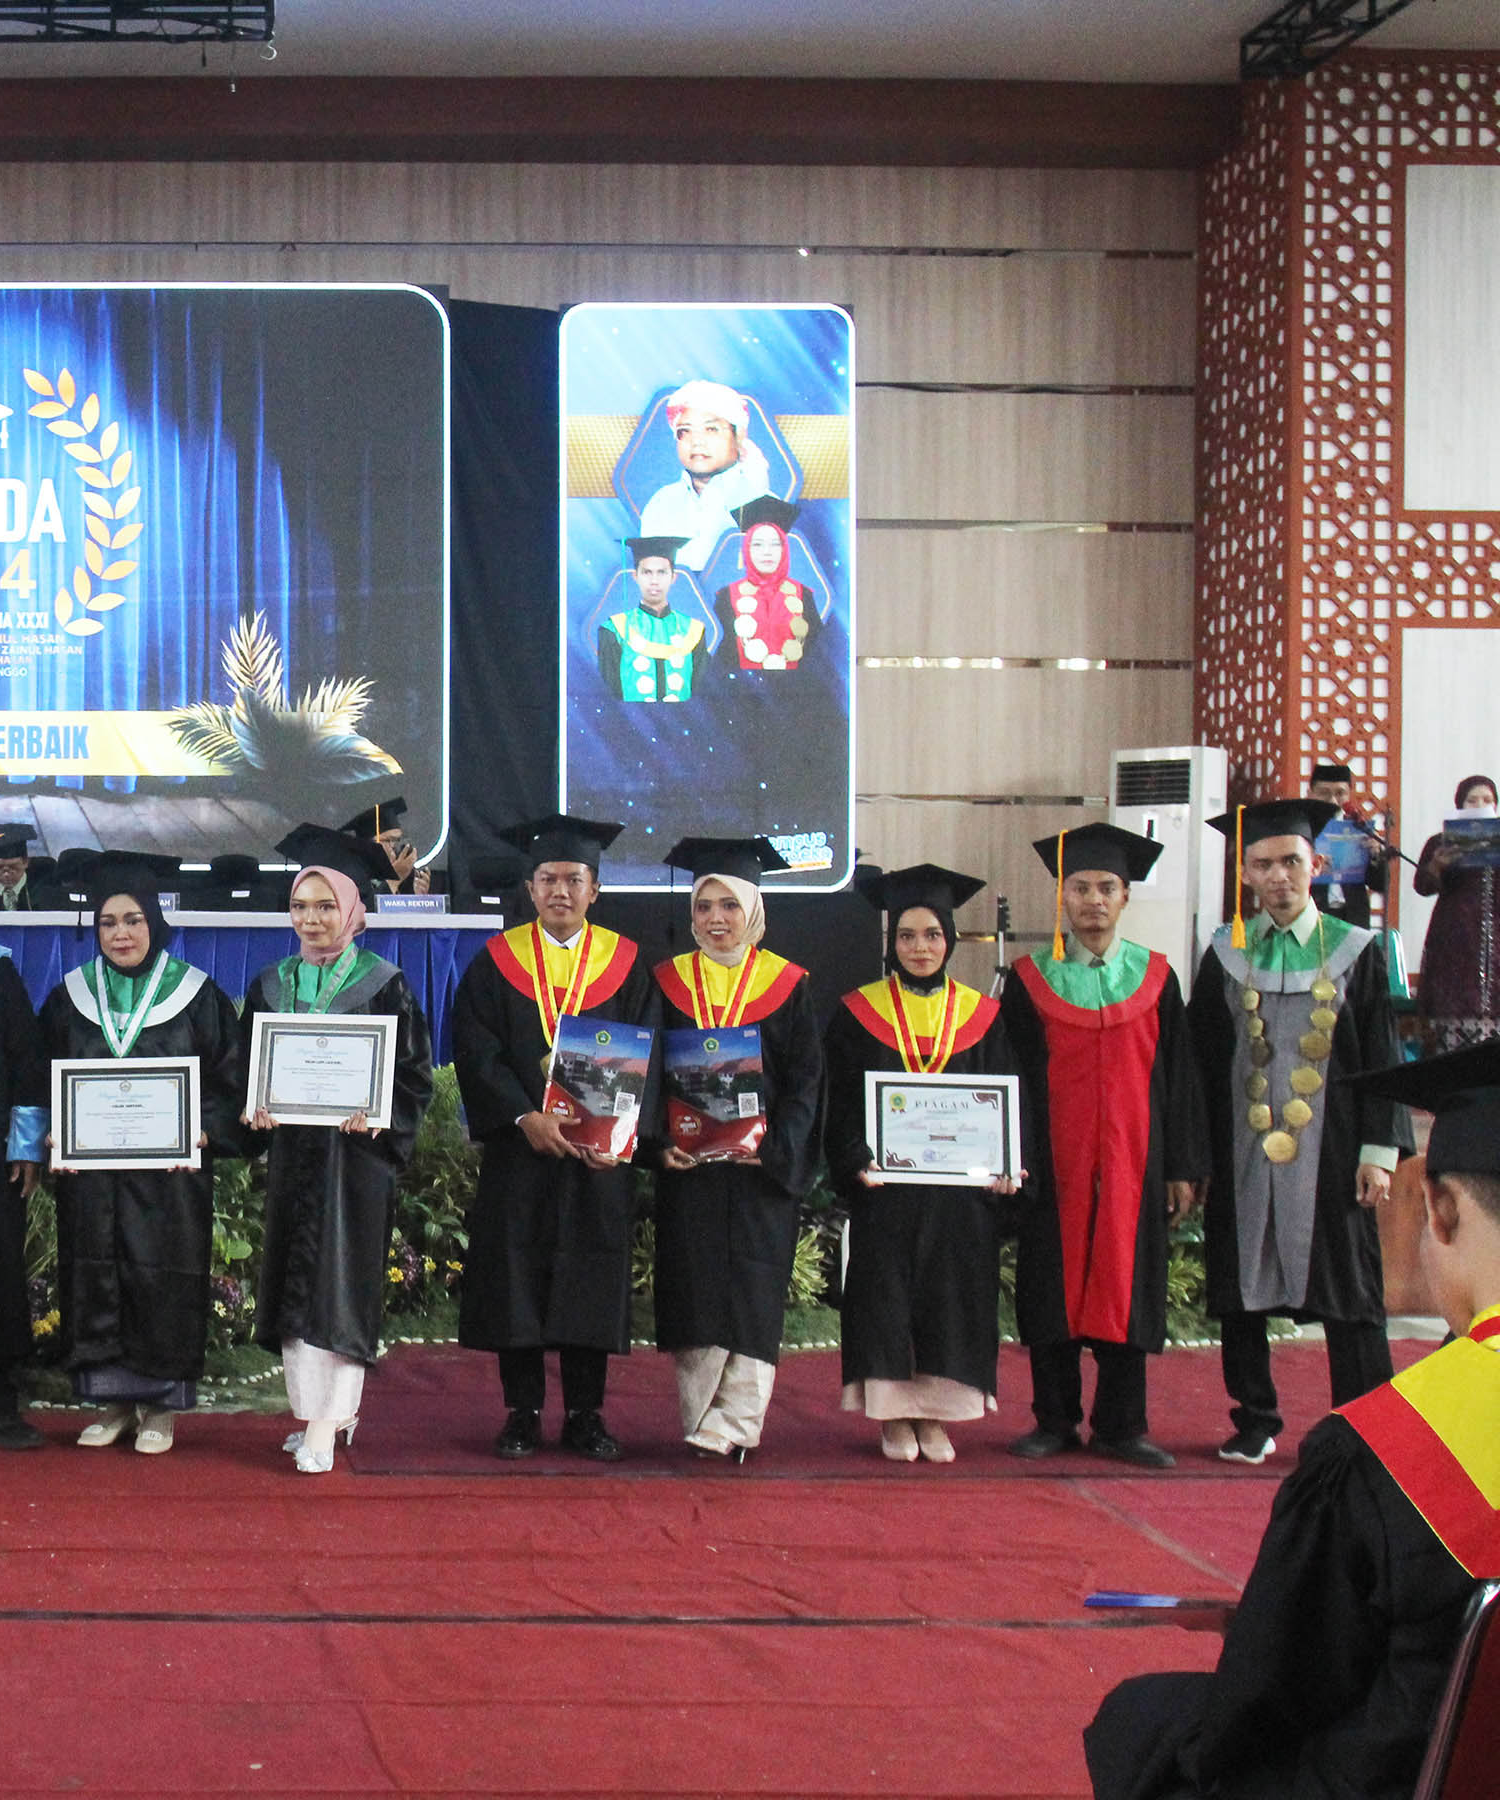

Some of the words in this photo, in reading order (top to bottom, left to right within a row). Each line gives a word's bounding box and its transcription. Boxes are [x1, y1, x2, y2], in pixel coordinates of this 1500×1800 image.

[16, 612, 50, 628] XXXI
[21, 634, 66, 644] HASAN
[407, 900, 435, 908] REKTOR
[915, 1100, 970, 1110] PIAGAM
